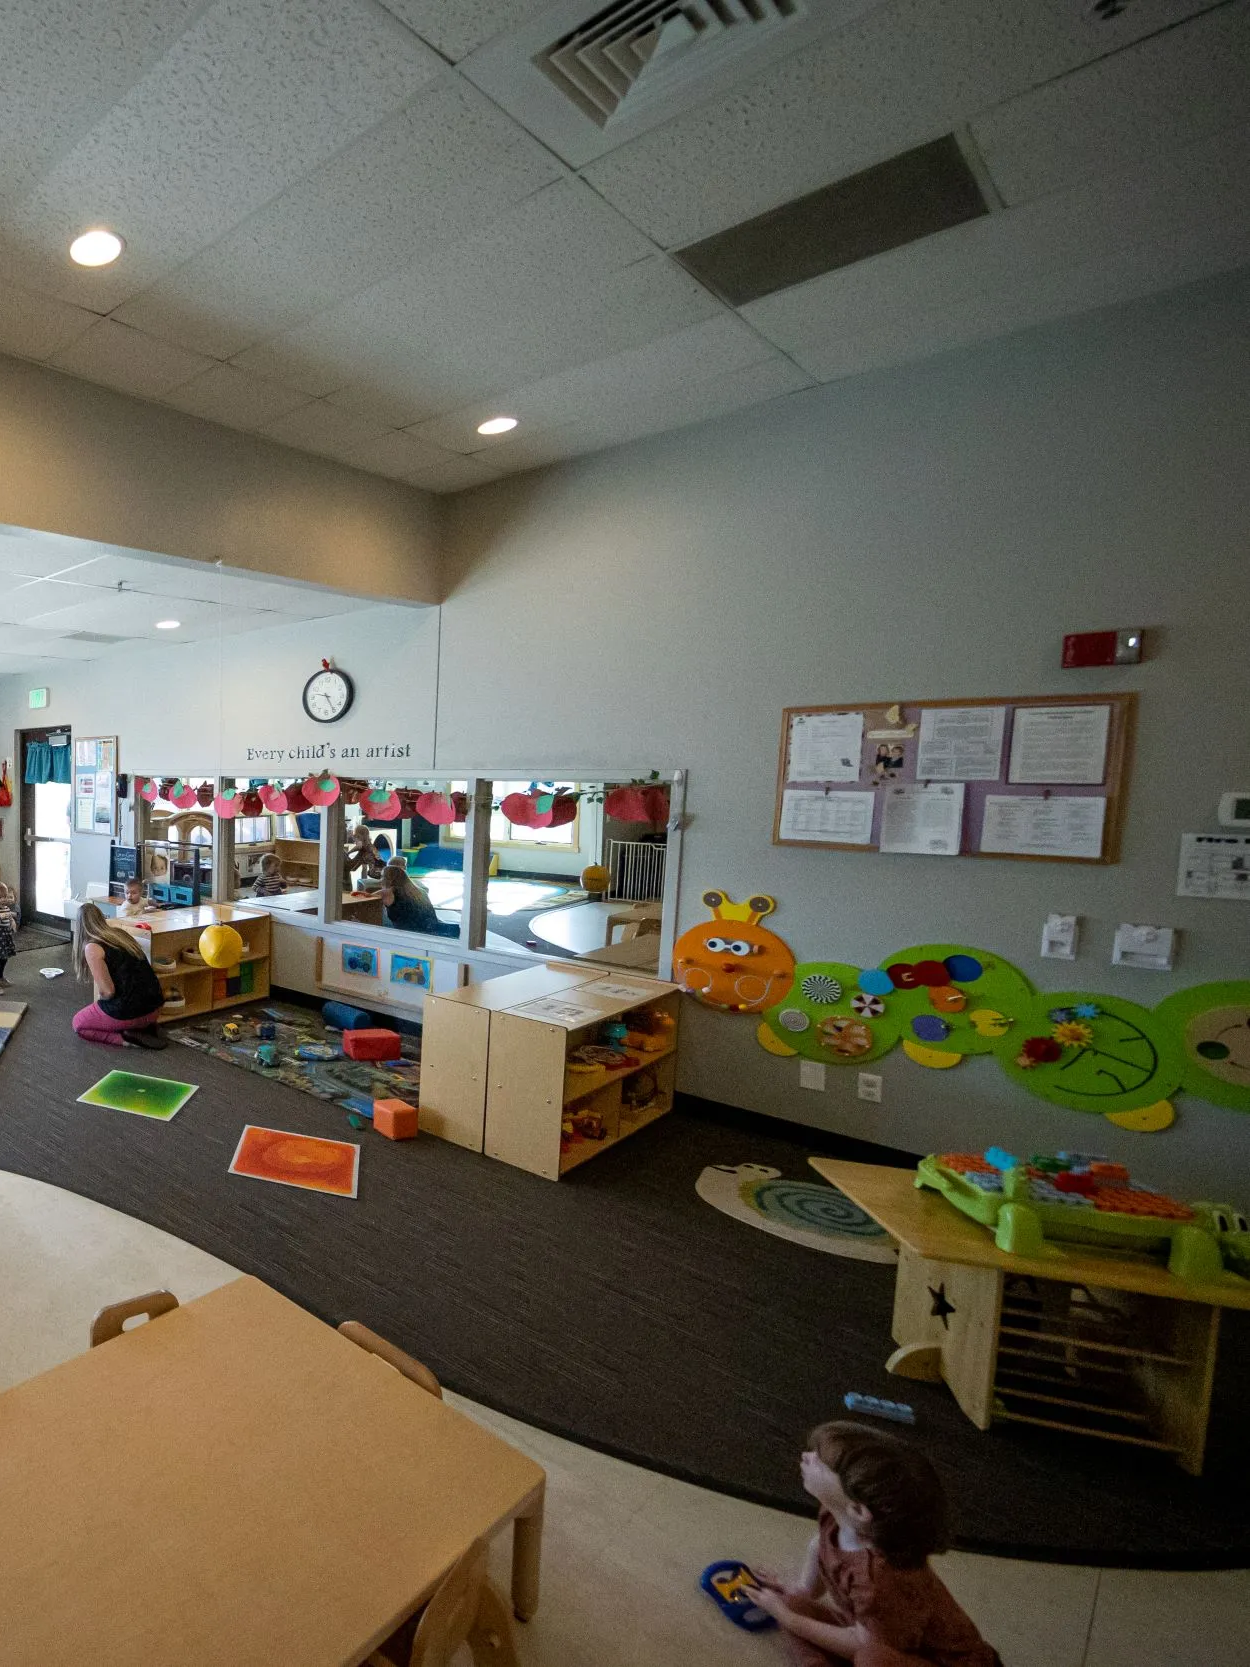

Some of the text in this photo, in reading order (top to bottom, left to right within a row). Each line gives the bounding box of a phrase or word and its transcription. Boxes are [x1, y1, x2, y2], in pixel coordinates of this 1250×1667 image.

[246, 742, 412, 764] Every child's an artist
